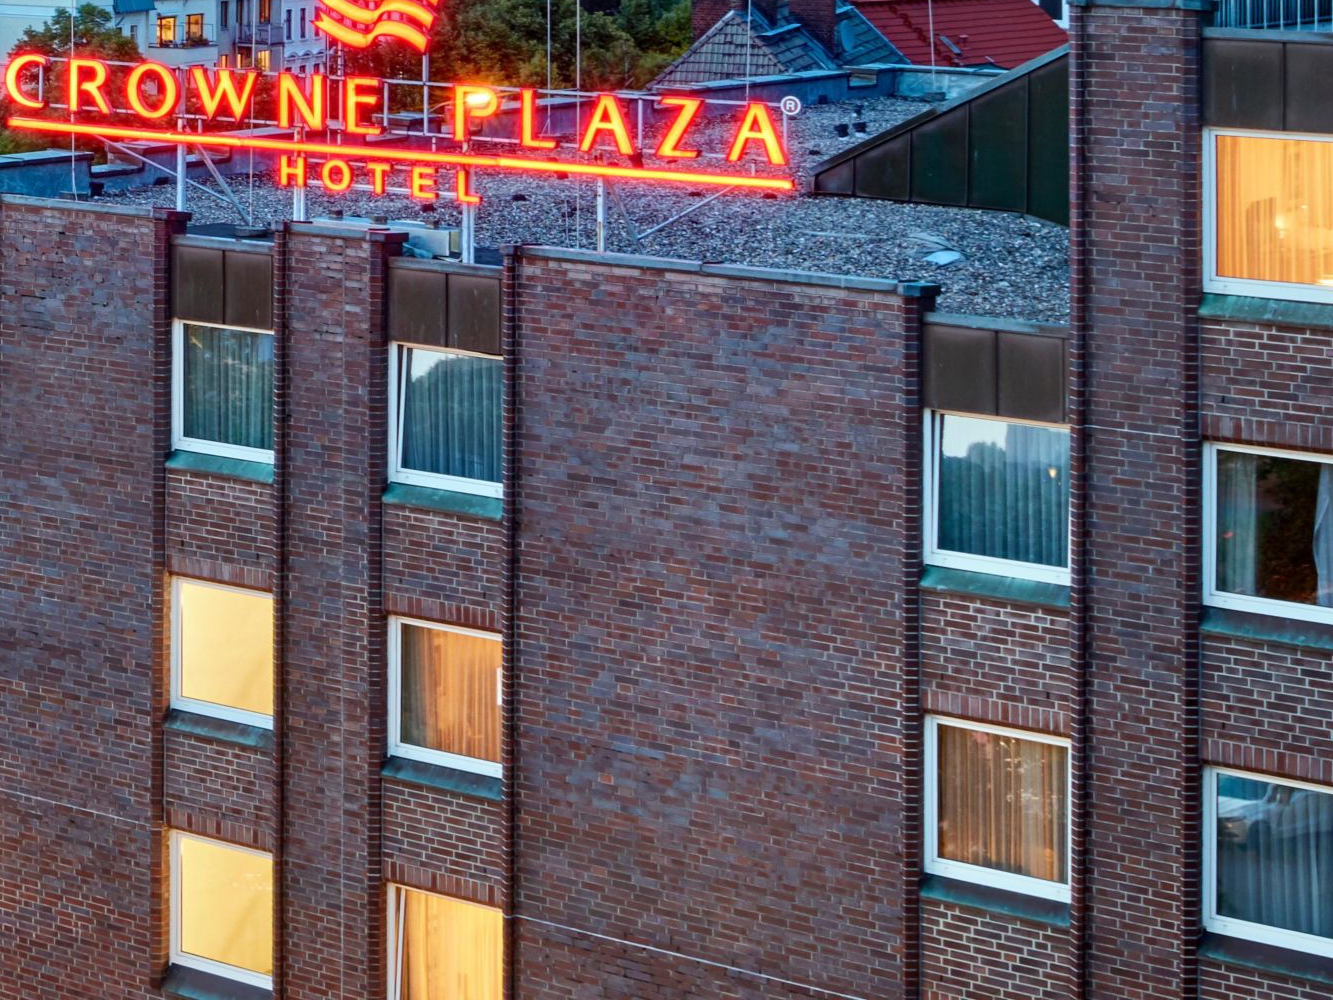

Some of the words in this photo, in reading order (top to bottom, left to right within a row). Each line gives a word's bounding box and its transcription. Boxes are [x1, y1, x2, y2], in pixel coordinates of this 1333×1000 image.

[5, 54, 382, 136] CROWNE
[452, 85, 787, 166] PLAZA
[279, 155, 482, 204] HOTEL
